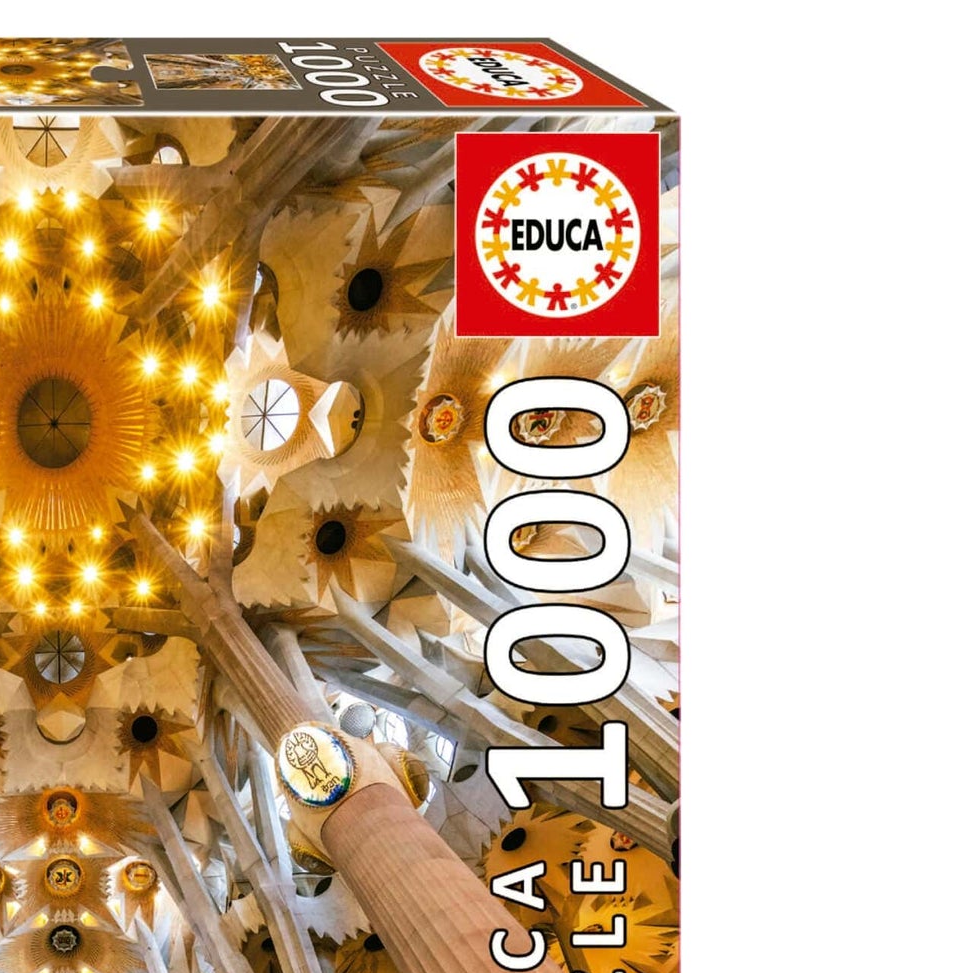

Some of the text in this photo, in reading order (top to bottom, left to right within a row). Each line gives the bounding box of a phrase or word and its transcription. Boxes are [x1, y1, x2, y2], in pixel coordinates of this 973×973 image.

[277, 41, 390, 107] 1000
[345, 46, 419, 99] PUZZLE
[467, 57, 530, 87] EDUCA
[511, 218, 604, 252] EDUCA
[484, 376, 631, 810] 1000
